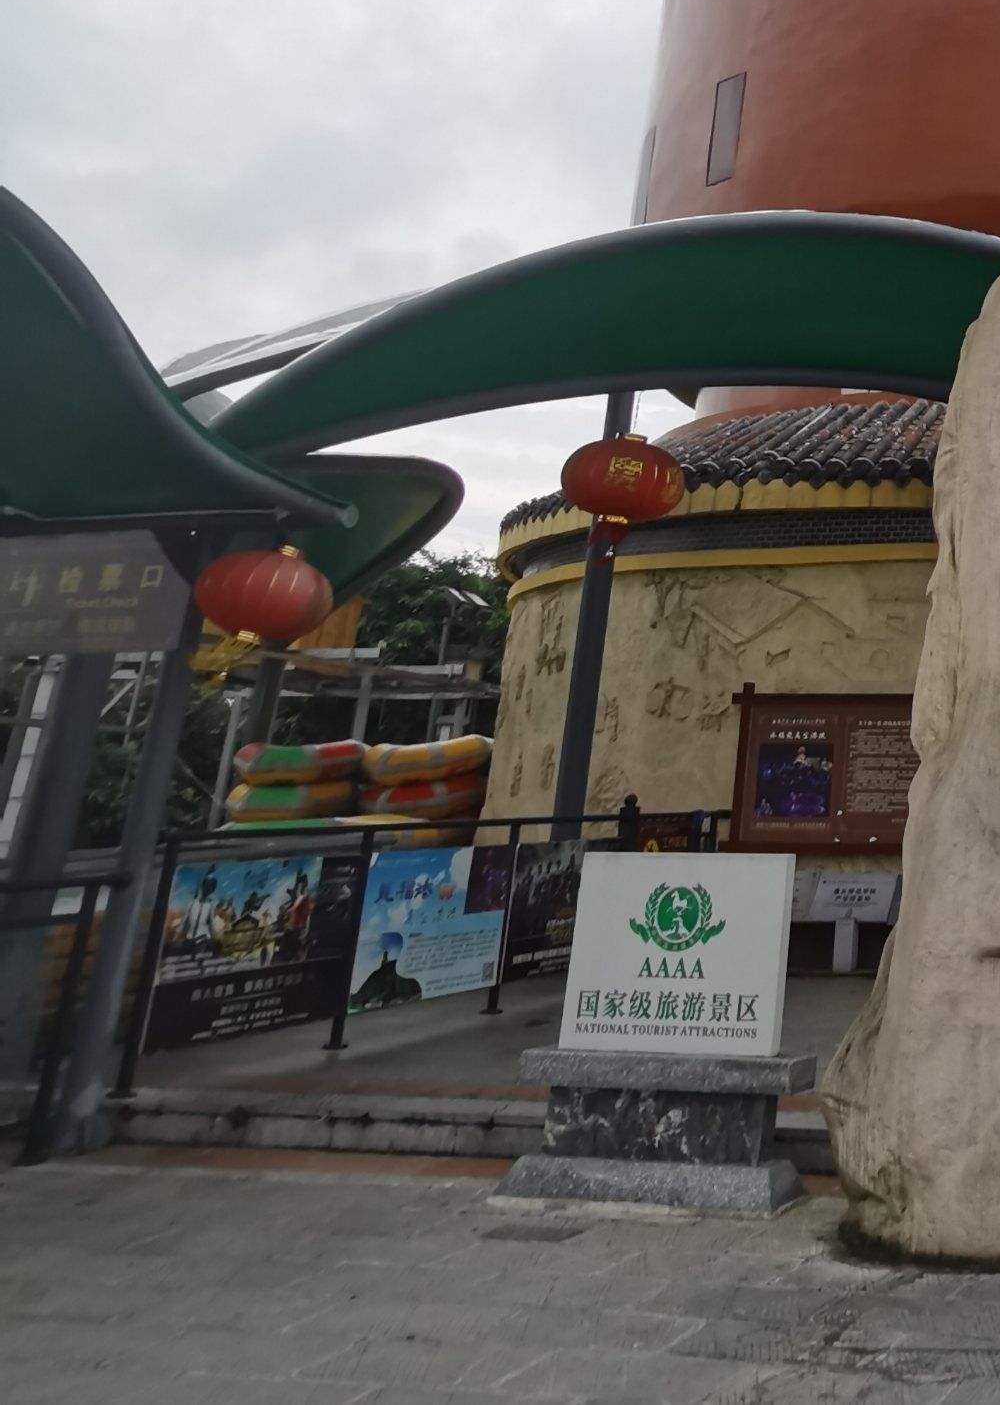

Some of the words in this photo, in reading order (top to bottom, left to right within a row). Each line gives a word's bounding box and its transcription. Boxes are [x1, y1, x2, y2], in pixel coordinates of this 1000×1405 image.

[638, 957, 705, 979] AAAA
[576, 989, 760, 1022] 国家级旅游景区
[575, 1023, 629, 1035] NATIONAL
[632, 1024, 678, 1036] TOURIST
[680, 1025, 758, 1039] ATTRACTIONS
